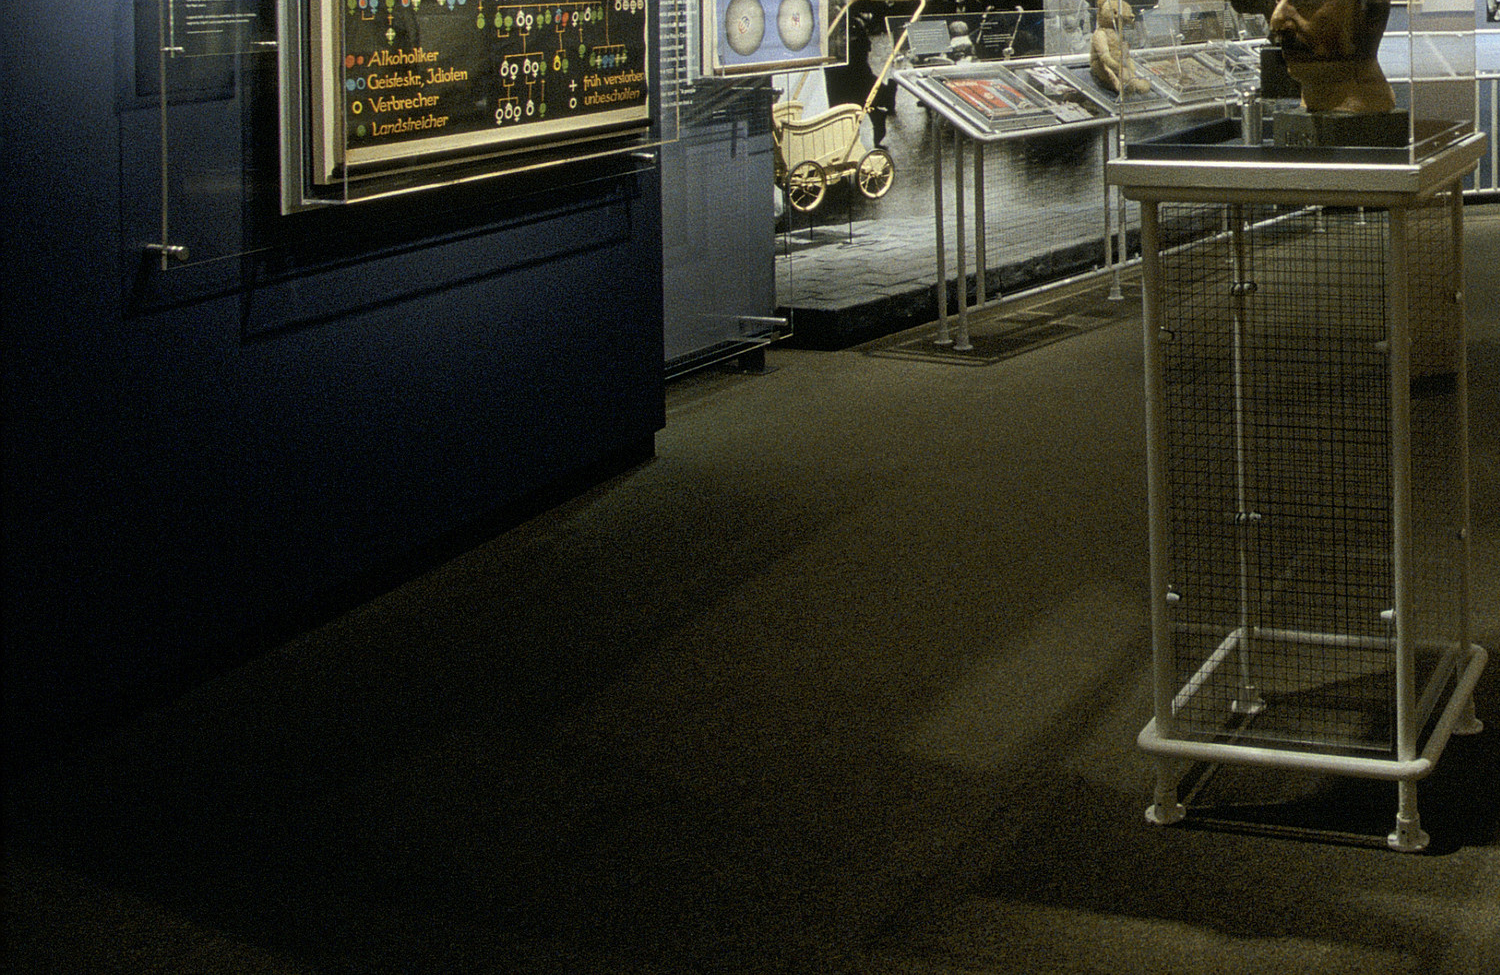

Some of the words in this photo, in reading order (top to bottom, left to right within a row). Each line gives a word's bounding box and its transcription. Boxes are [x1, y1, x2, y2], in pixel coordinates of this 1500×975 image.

[367, 48, 439, 67] Alkoholiker
[584, 74, 601, 91] früh
[368, 93, 440, 113] Verbrecher
[372, 114, 449, 136] Landstreicher
